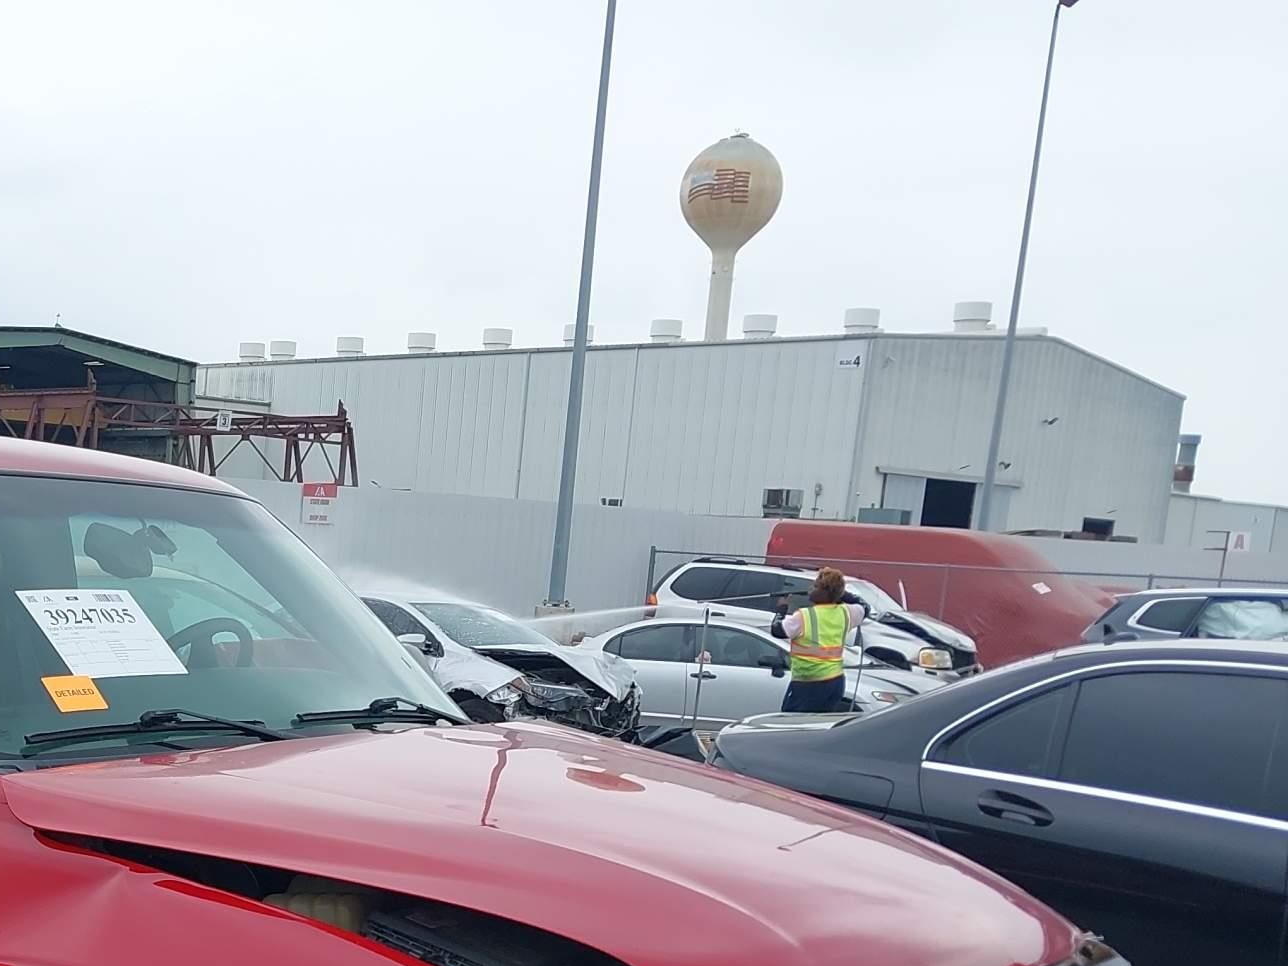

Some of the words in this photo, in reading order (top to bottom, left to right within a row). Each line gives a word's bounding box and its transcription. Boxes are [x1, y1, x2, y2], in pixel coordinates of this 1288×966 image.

[852, 355, 861, 368] 4
[1233, 534, 1245, 550] A
[44, 608, 136, 626] 39247035
[54, 688, 95, 698] DETAILED
